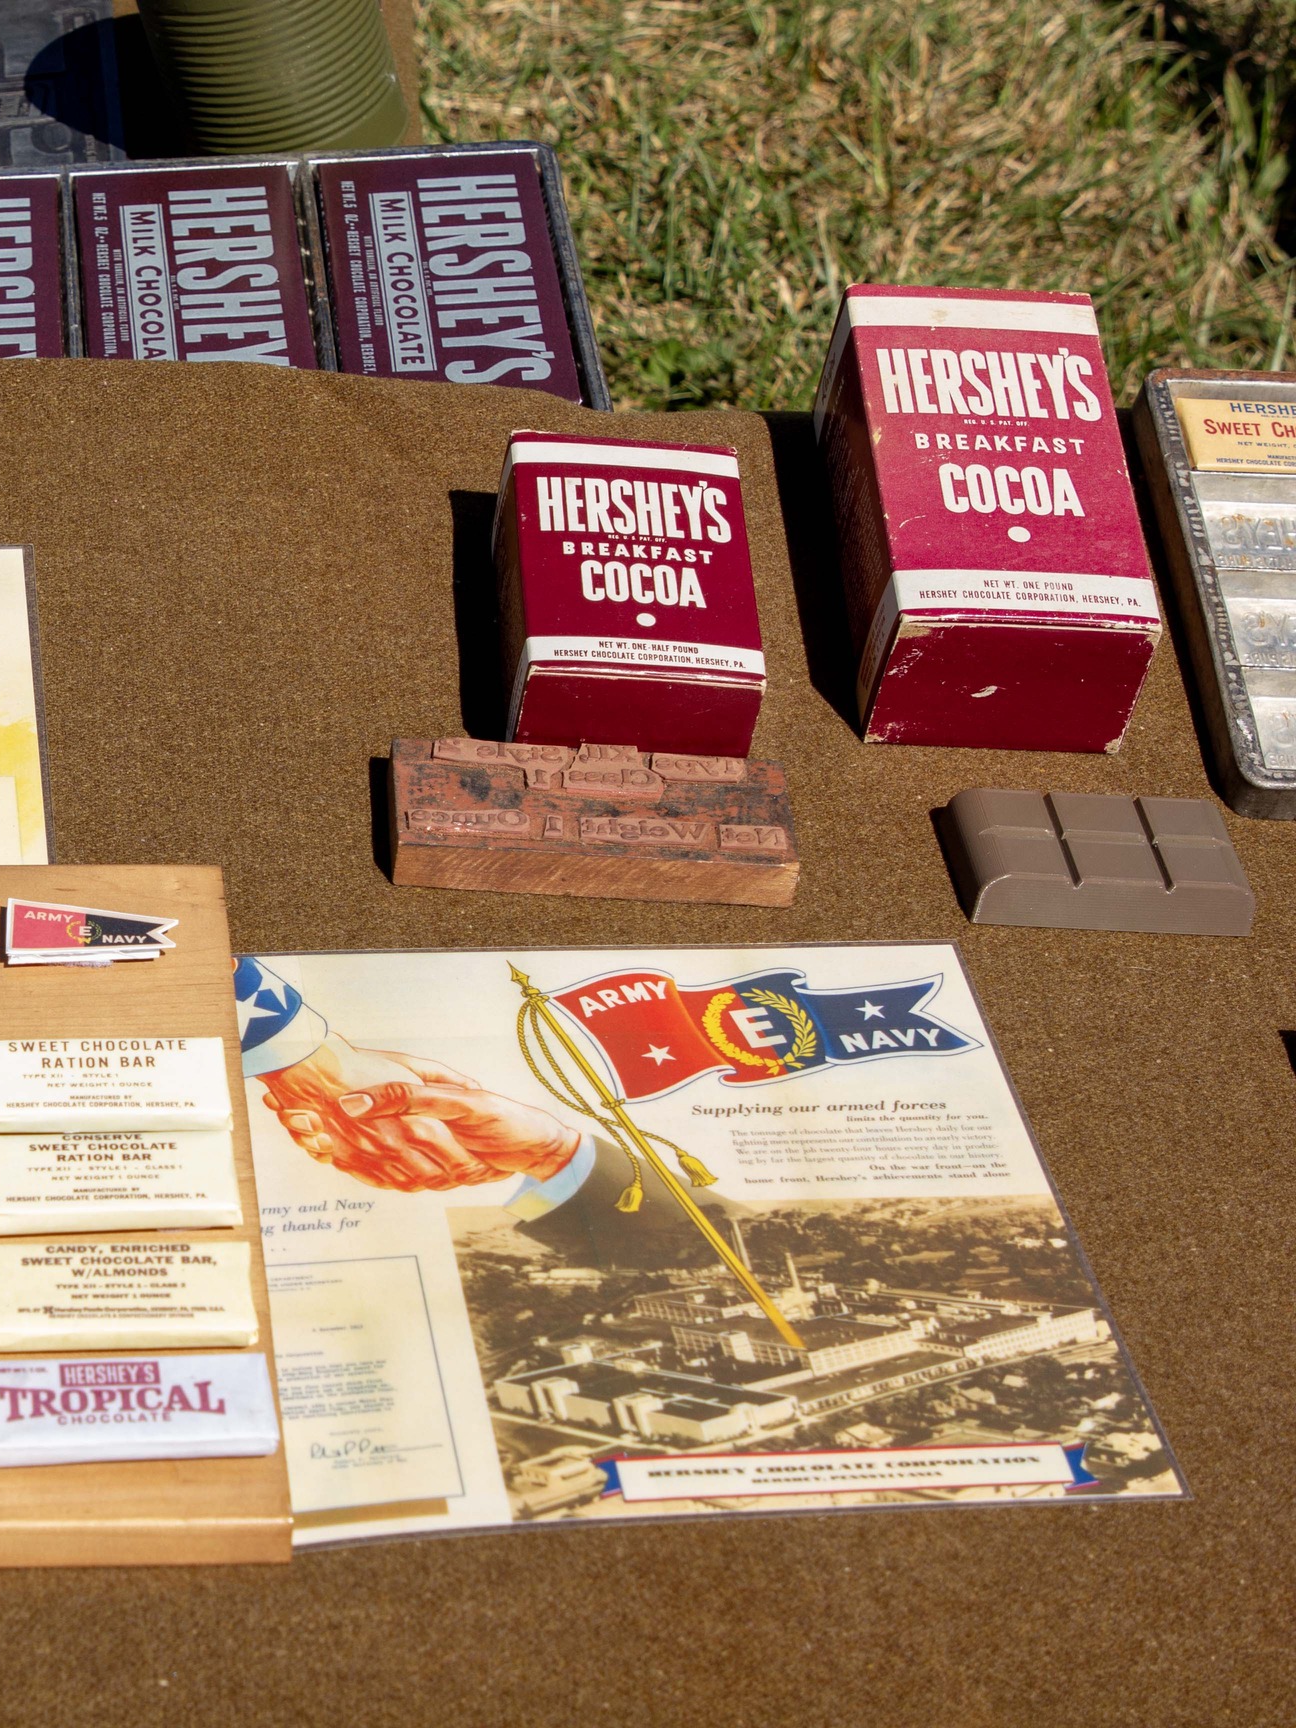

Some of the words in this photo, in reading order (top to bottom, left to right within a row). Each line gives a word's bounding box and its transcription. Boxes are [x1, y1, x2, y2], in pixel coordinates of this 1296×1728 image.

[379, 198, 407, 243] MILK
[129, 211, 157, 257] MILK
[417, 174, 555, 383] HERSHEY'S
[386, 251, 426, 365] CHOCOLATE
[876, 347, 1102, 422] HERSHEY'S
[1203, 418, 1261, 437] SWEET
[914, 433, 1085, 455] BREAKFAST
[1246, 459, 1282, 467] CHOCOLATE
[938, 463, 1085, 517] COCOA
[536, 476, 732, 544] HERSHEY'S
[562, 541, 713, 564] BREAKFAST
[580, 560, 707, 609] COCOA
[984, 580, 999, 588] NET
[1004, 581, 1019, 589] WT.
[1023, 581, 1040, 590] ONE
[1044, 582, 1073, 591] POUND
[919, 590, 957, 599] HERSHEY
[962, 590, 1011, 601] CHOCOLATE
[1015, 592, 1079, 604] CORPORATION,
[1082, 594, 1125, 606] HERSHEY,
[1127, 597, 1142, 608] PA.
[616, 642, 630, 650] WT.
[673, 645, 699, 654] POUND
[554, 649, 588, 658] HERSHEY
[591, 650, 635, 660] CHOCOLATE
[638, 653, 694, 665] CORPORATION,
[695, 657, 732, 668] HERSHEY,
[734, 660, 746, 669] PA.
[23, 909, 75, 924] ARMY
[78, 925, 93, 938] E
[101, 933, 149, 945] NAVY
[578, 980, 668, 1018] ARMY
[734, 1008, 788, 1050] E
[839, 1028, 940, 1053] NAVY
[8, 1041, 70, 1053] SWEET
[80, 1039, 188, 1052] CHOCOLATE
[41, 1056, 109, 1069] RATION
[120, 1056, 156, 1068] BAR
[691, 1102, 784, 1118] Supplying
[788, 1104, 820, 1114] our
[827, 1100, 885, 1112] armed
[891, 1099, 947, 1113] forces
[846, 1114, 875, 1122] limits
[879, 1114, 895, 1122] the
[899, 1114, 942, 1124] quantity
[946, 1113, 961, 1122] for
[29, 1143, 79, 1152] SWEET
[87, 1142, 178, 1152] CHOCOLATE
[56, 1153, 115, 1162] RATION
[122, 1153, 152, 1162] BAR
[298, 1199, 328, 1213] and
[335, 1198, 376, 1213] Navy
[281, 1217, 333, 1232] thanks
[338, 1217, 362, 1233] for
[46, 1245, 104, 1255] CANDY,
[110, 1244, 191, 1254] ENRICHED
[21, 1257, 72, 1266] SWEET
[80, 1256, 174, 1266] CHOCOLATE
[181, 1255, 218, 1267] BAR,
[72, 1268, 168, 1278] W/ALMONDS
[64, 1363, 156, 1385] HERSHEY'S
[57, 1412, 172, 1426] CHOCOLATE
[648, 1464, 747, 1479] HERSHEY
[755, 1460, 877, 1476] CHOCOLATE
[885, 1455, 1042, 1471] CORPORATION
